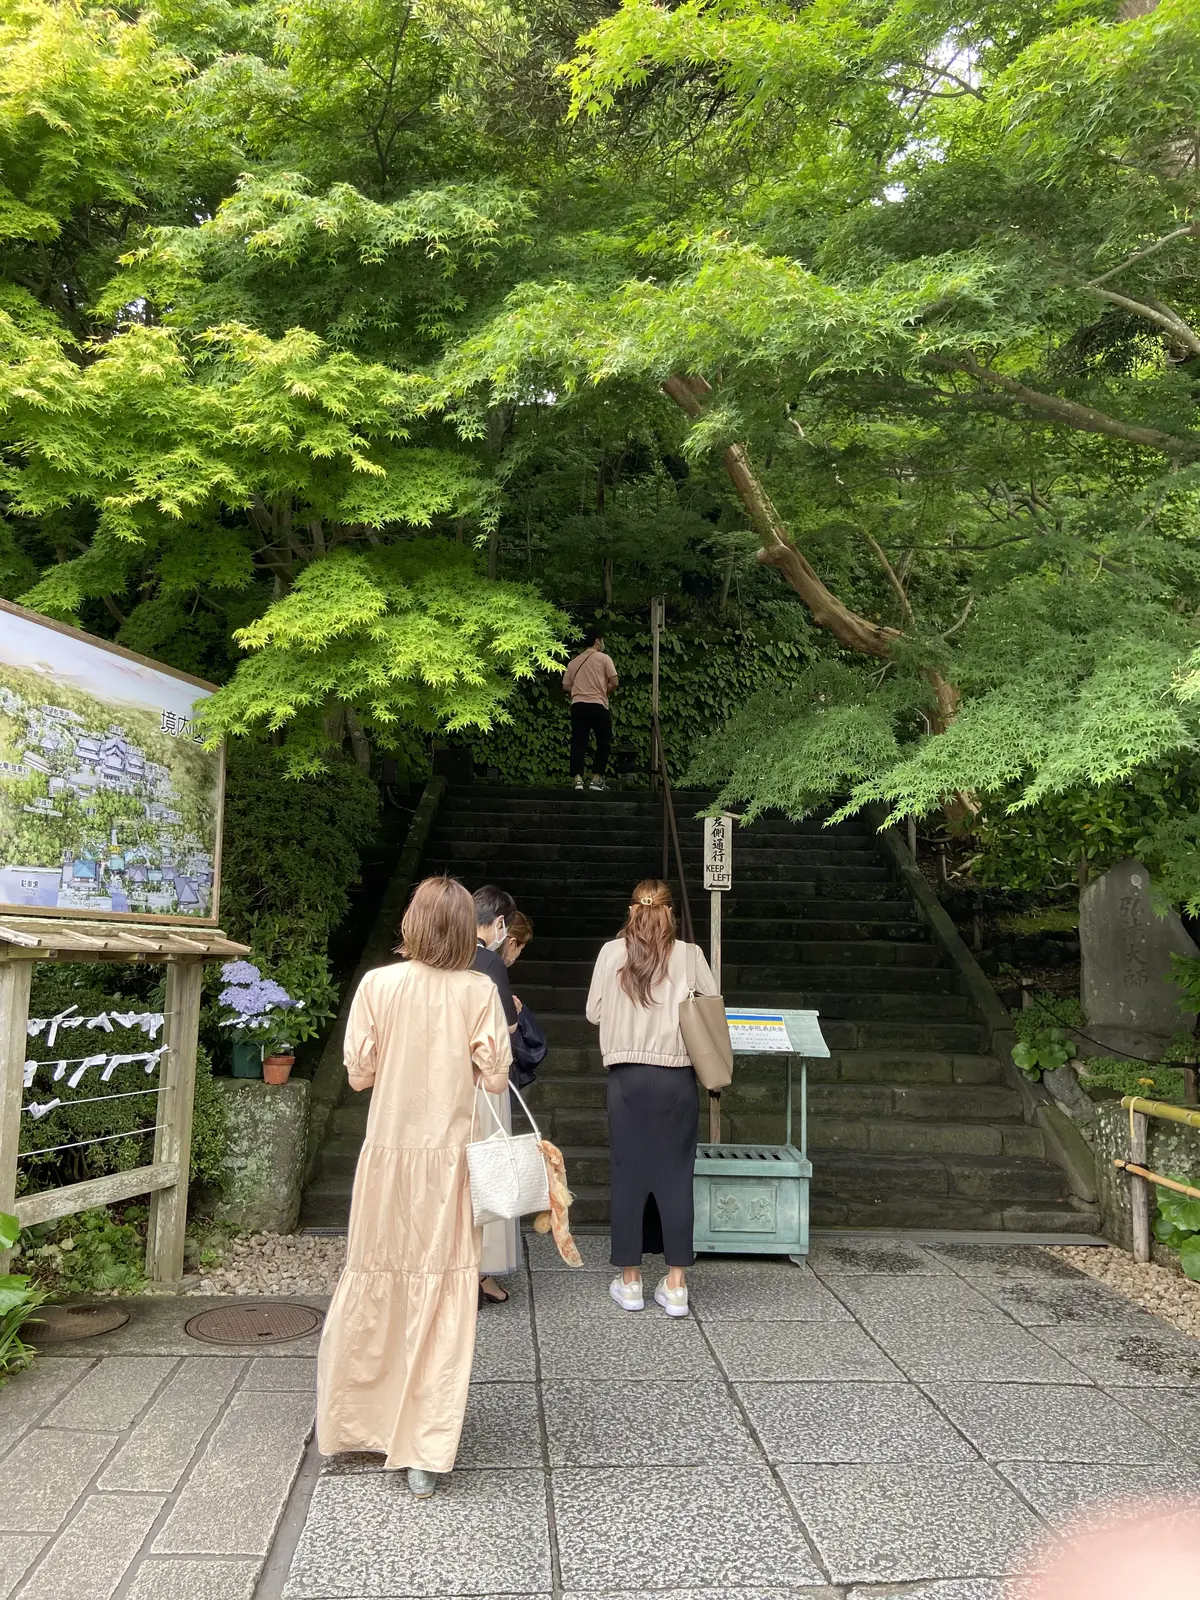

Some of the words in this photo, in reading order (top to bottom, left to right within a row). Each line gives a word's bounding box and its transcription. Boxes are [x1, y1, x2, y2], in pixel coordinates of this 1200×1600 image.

[711, 817, 725, 862] 左側通行
[706, 865, 725, 873] KEEP
[1119, 896, 1151, 989] 弘法大師
